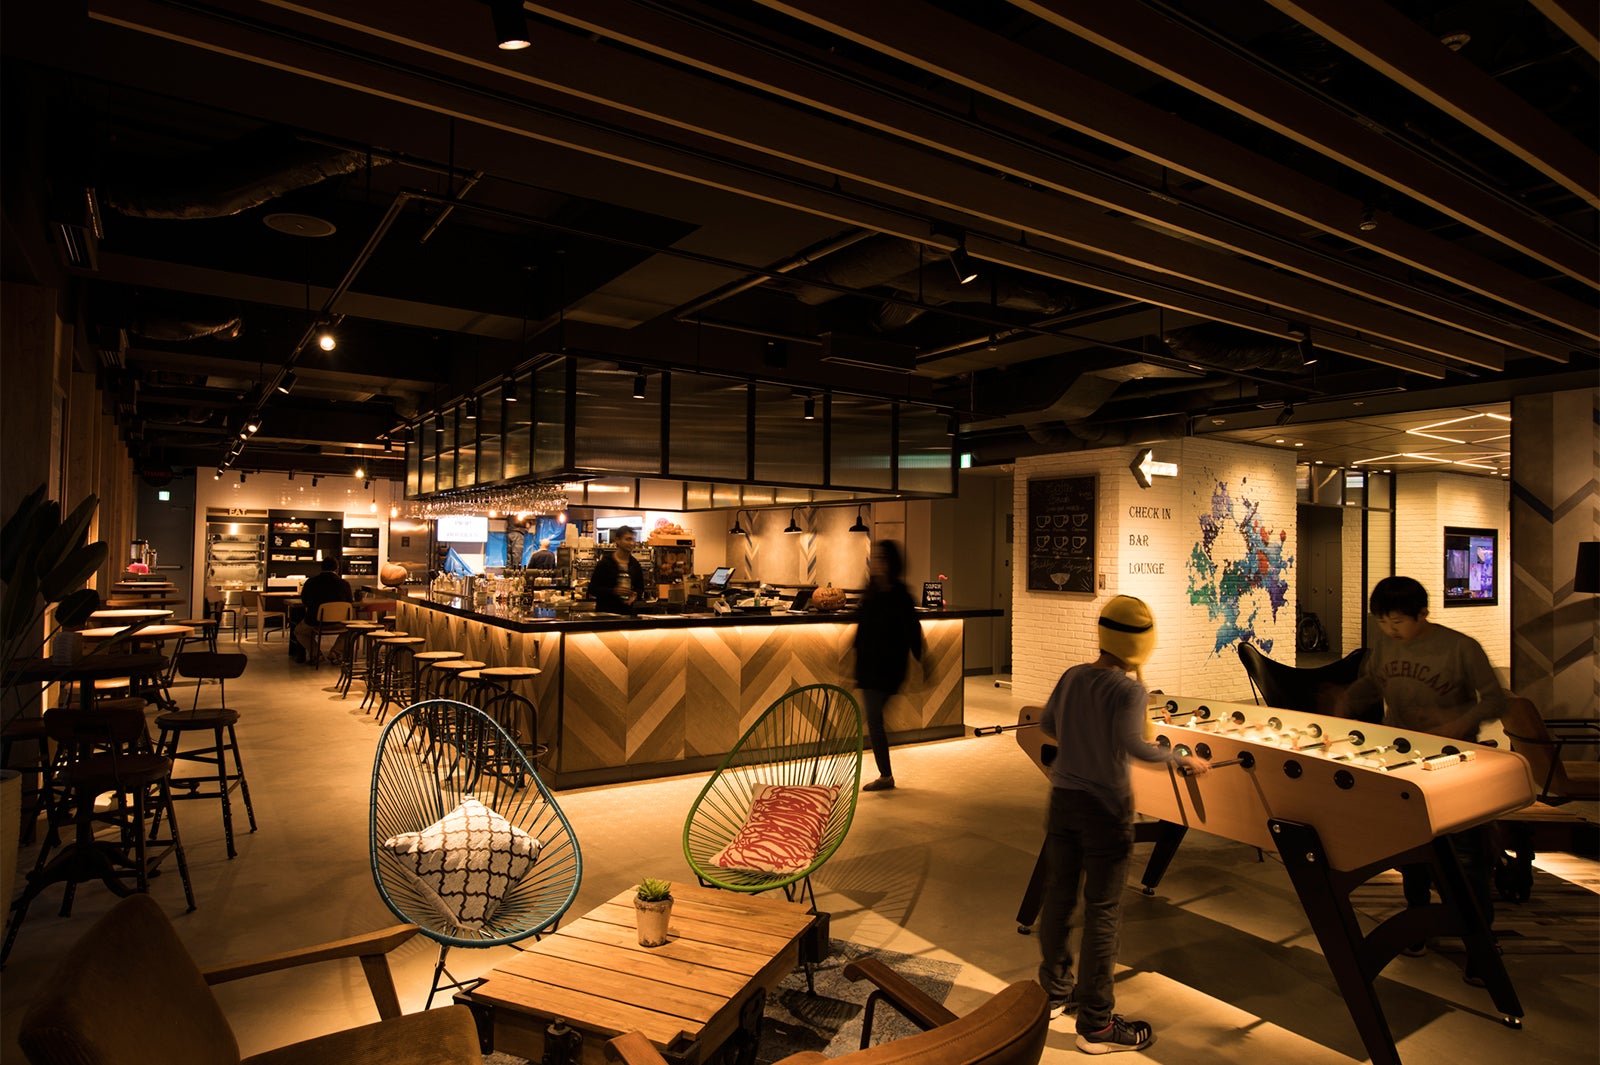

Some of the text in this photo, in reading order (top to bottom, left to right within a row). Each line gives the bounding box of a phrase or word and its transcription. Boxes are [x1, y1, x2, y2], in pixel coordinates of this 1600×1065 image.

[228, 507, 248, 516] EAT
[1129, 506, 1171, 520] CHECK IN
[1129, 534, 1149, 547] BAR
[1129, 562, 1165, 575] LOUNGE
